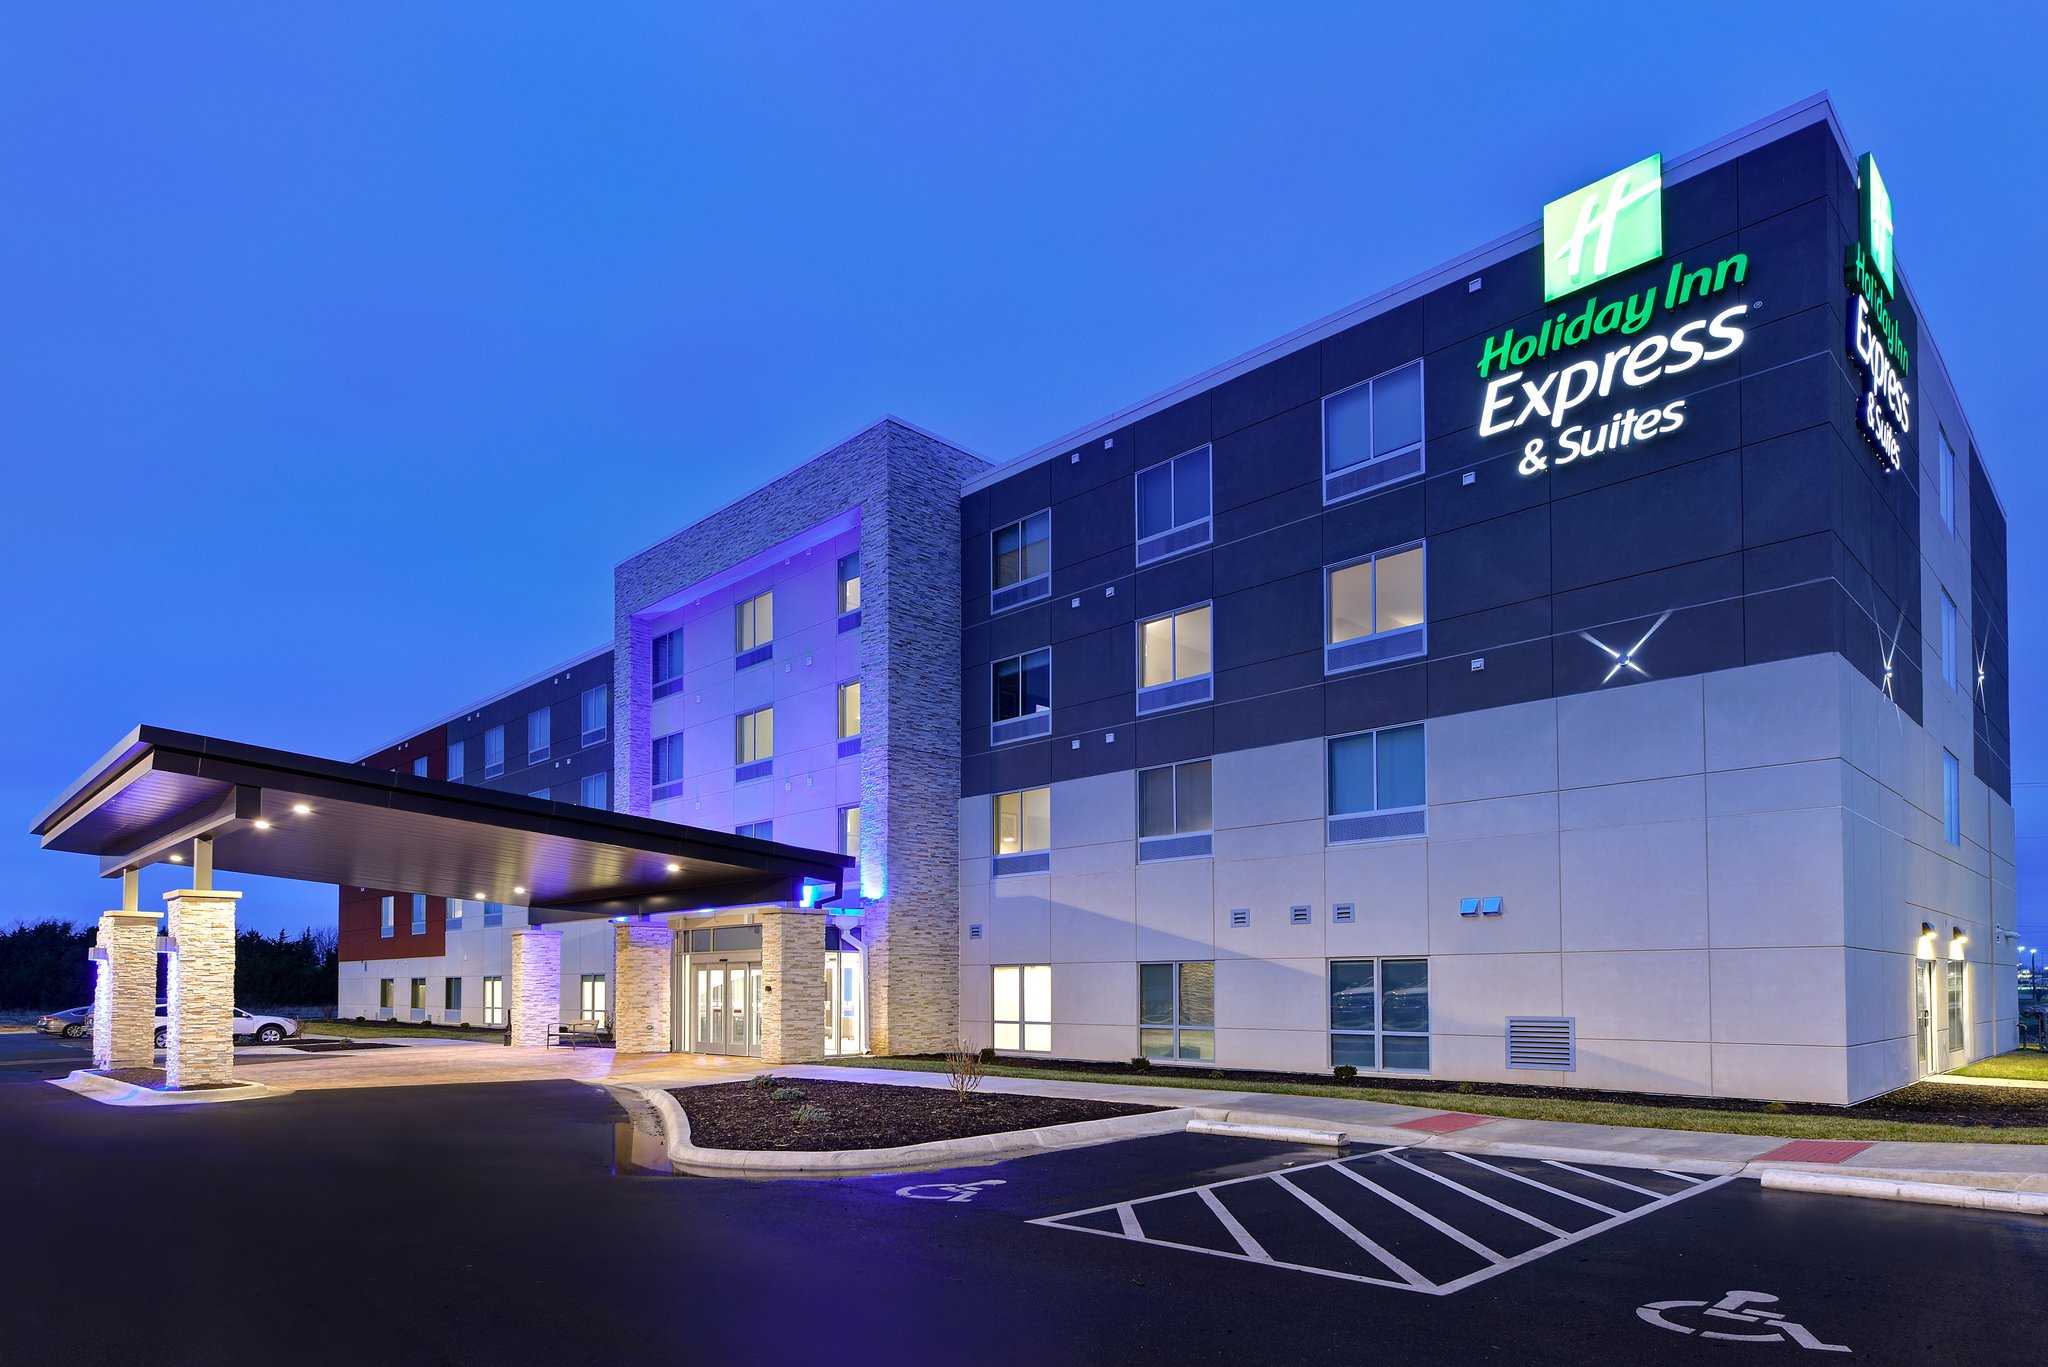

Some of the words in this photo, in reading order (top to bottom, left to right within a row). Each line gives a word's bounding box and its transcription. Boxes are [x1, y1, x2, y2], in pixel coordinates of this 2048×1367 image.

[1477, 286, 1659, 379] Holiday
[1664, 252, 1748, 310] Inn
[1478, 304, 1748, 438] Express
[1855, 240, 1894, 356] Holiday
[1894, 319, 1909, 377] Inn
[1856, 293, 1910, 433] Express
[1517, 437, 1548, 476] &
[1554, 399, 1687, 465] Suites
[1867, 391, 1875, 431] &
[1875, 404, 1901, 471] Suites
